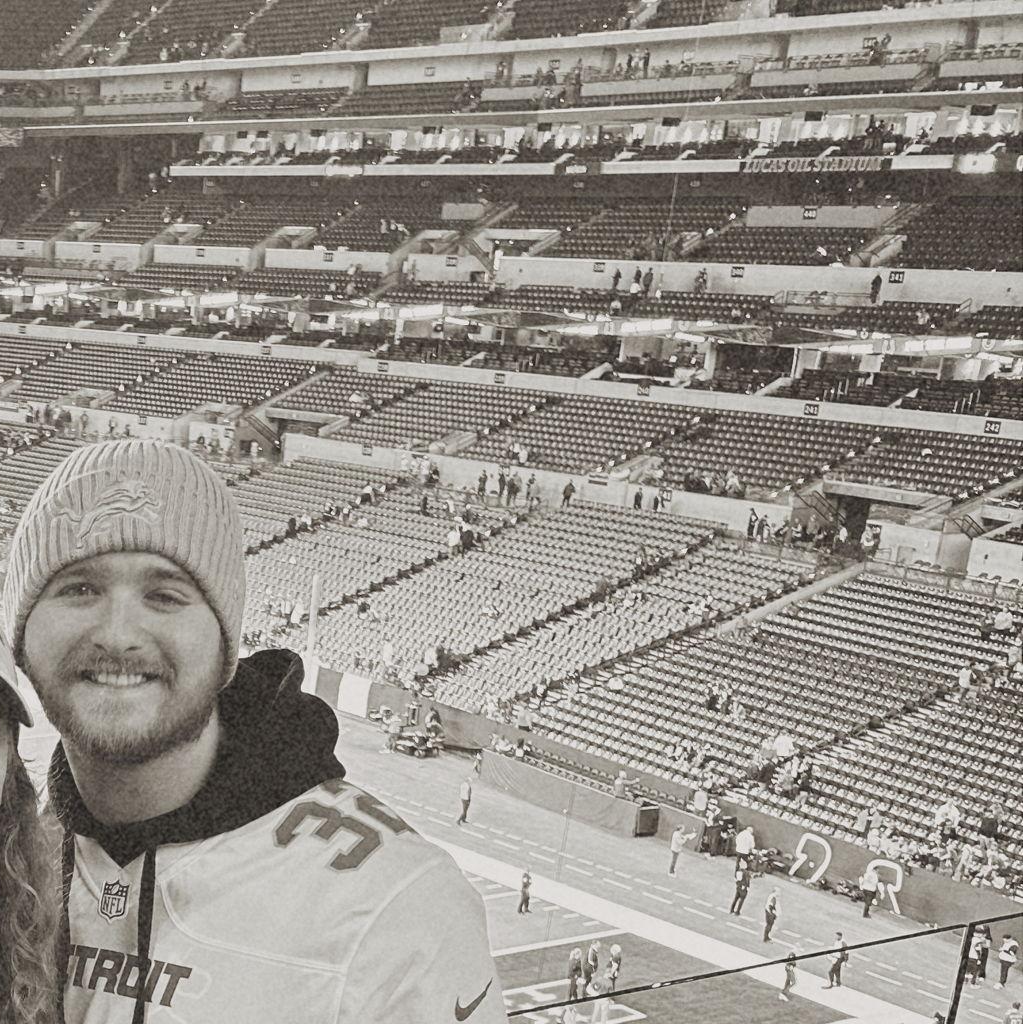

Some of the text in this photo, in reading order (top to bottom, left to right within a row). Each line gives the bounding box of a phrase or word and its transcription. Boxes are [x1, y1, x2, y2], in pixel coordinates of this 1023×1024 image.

[743, 157, 882, 173] LUCAS OIL STADIUM
[985, 422, 1000, 433] 242
[103, 896, 123, 914] NFL
[68, 944, 193, 1008] TROIT
